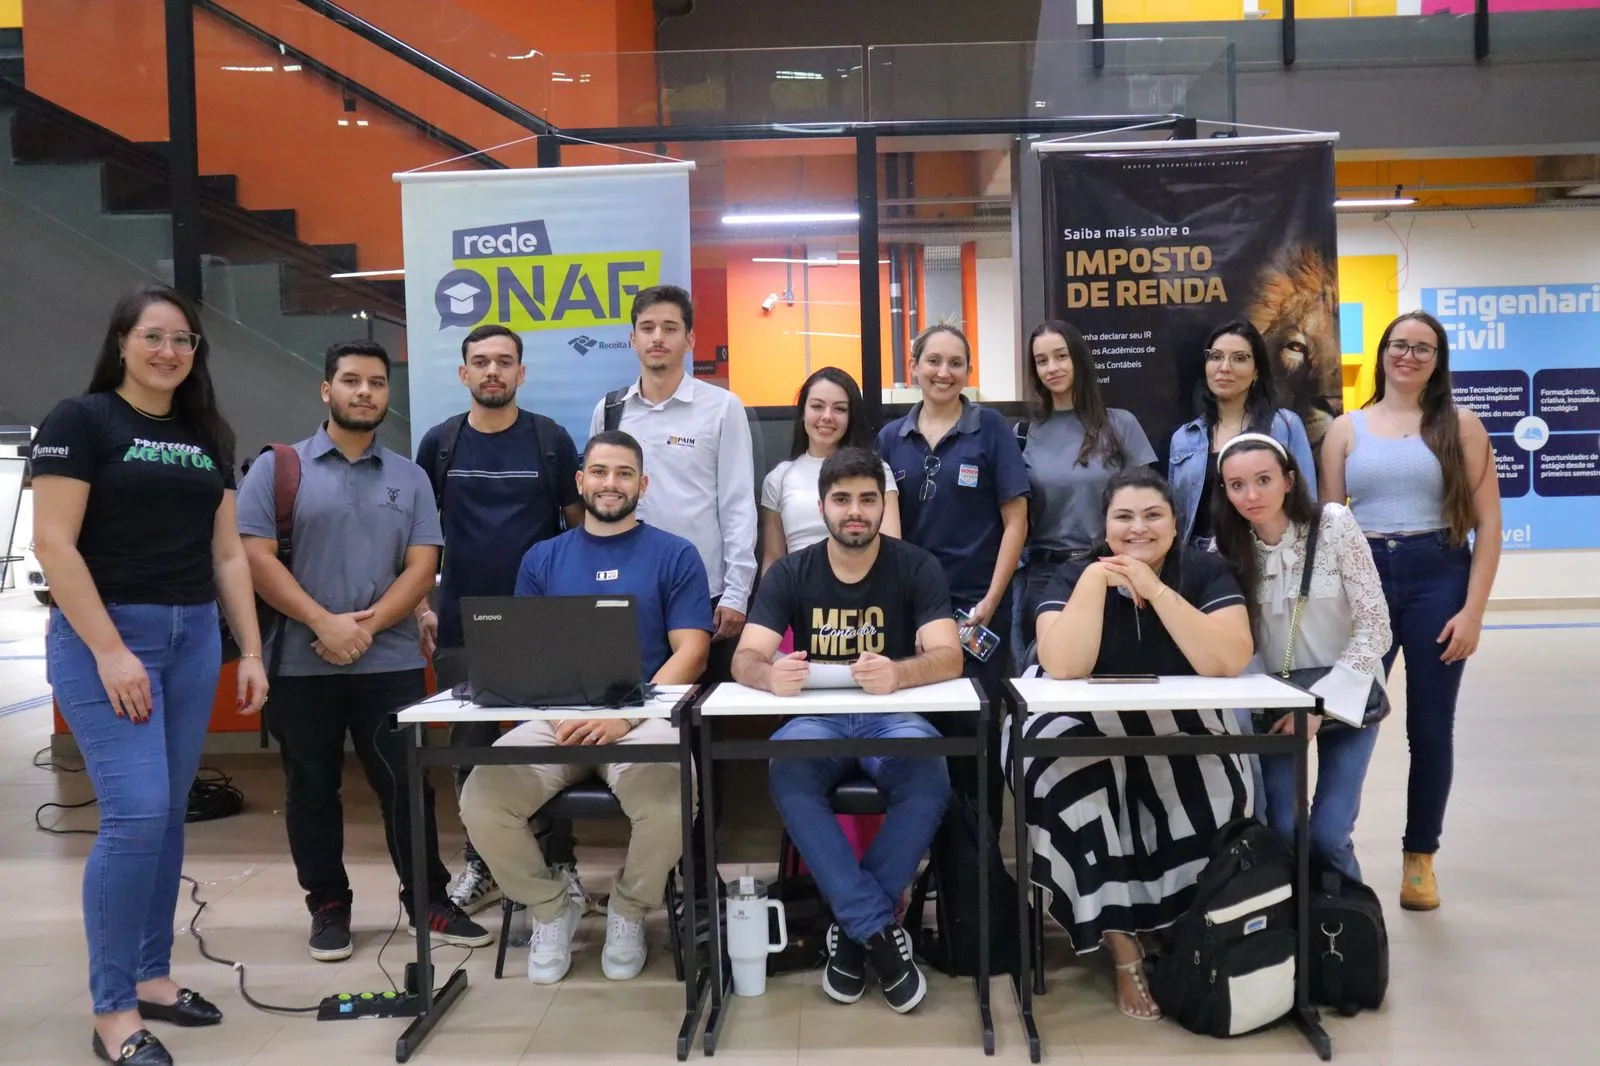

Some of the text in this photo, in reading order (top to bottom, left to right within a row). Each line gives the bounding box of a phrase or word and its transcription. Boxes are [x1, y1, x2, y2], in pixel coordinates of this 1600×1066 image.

[1064, 225, 1190, 240] Saiba mais sobre o
[464, 227, 537, 255] rede
[1066, 245, 1212, 277] IMPOSTO
[1067, 276, 1228, 308] DE RENDA
[1437, 286, 1600, 322] Engenhari
[1099, 332, 1128, 340] declarar
[1129, 331, 1142, 339] seu
[1143, 330, 1152, 338] IR
[599, 341, 627, 350] Receita
[1102, 346, 1145, 355] Acadêmicos
[1146, 345, 1156, 353] de
[1106, 360, 1142, 369] Contábeis
[1469, 386, 1508, 395] Tecnológico
[1540, 388, 1573, 396] Formação
[1486, 394, 1520, 402] inspirados
[1540, 404, 1578, 412] tecnológica
[133, 438, 203, 455] PROFESSOR
[122, 446, 217, 472] MENTOR
[1540, 454, 1589, 462] Oportunidades
[1566, 461, 1586, 469] desde
[1541, 470, 1572, 478] primeiros
[473, 613, 503, 621] Lenovo
[820, 621, 877, 639] Contador
